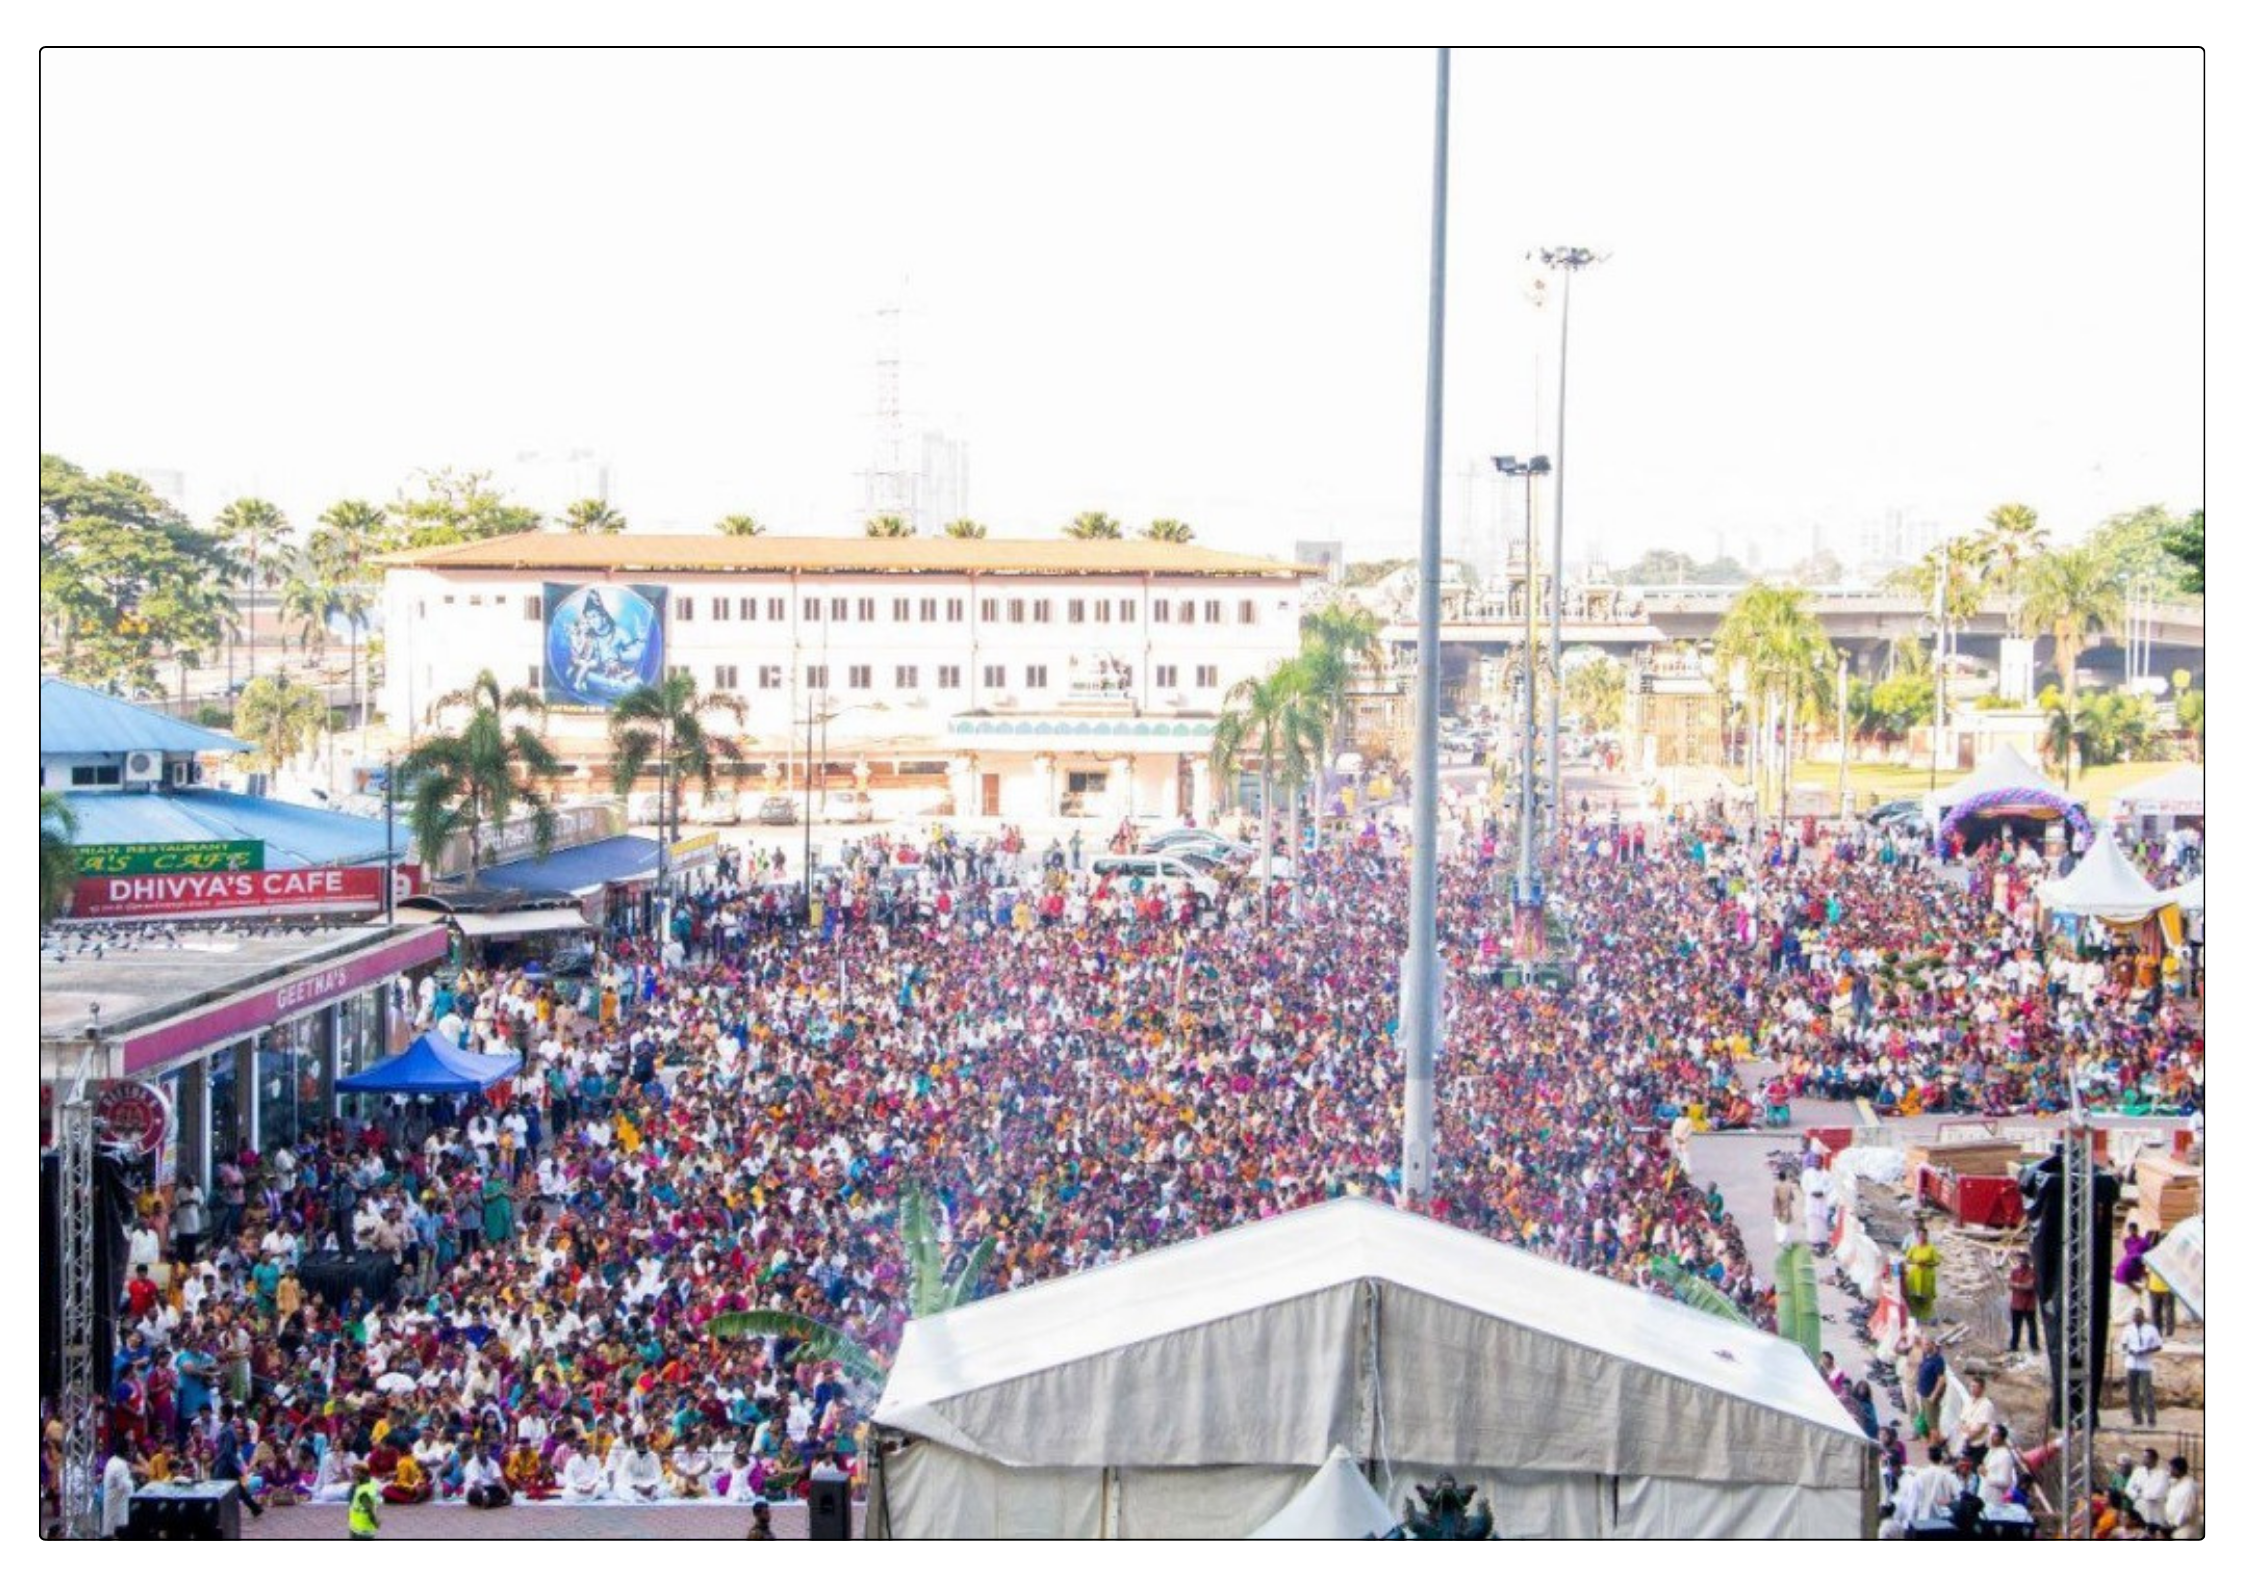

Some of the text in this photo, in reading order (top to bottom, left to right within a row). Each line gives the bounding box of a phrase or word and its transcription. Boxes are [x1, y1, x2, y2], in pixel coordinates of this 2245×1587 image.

[79, 843, 229, 855] RIAN RESTAURANT
[79, 854, 131, 873] A'S
[109, 870, 343, 901] DHIVYA'S CAFE
[277, 967, 347, 1010] GEETHA'S
